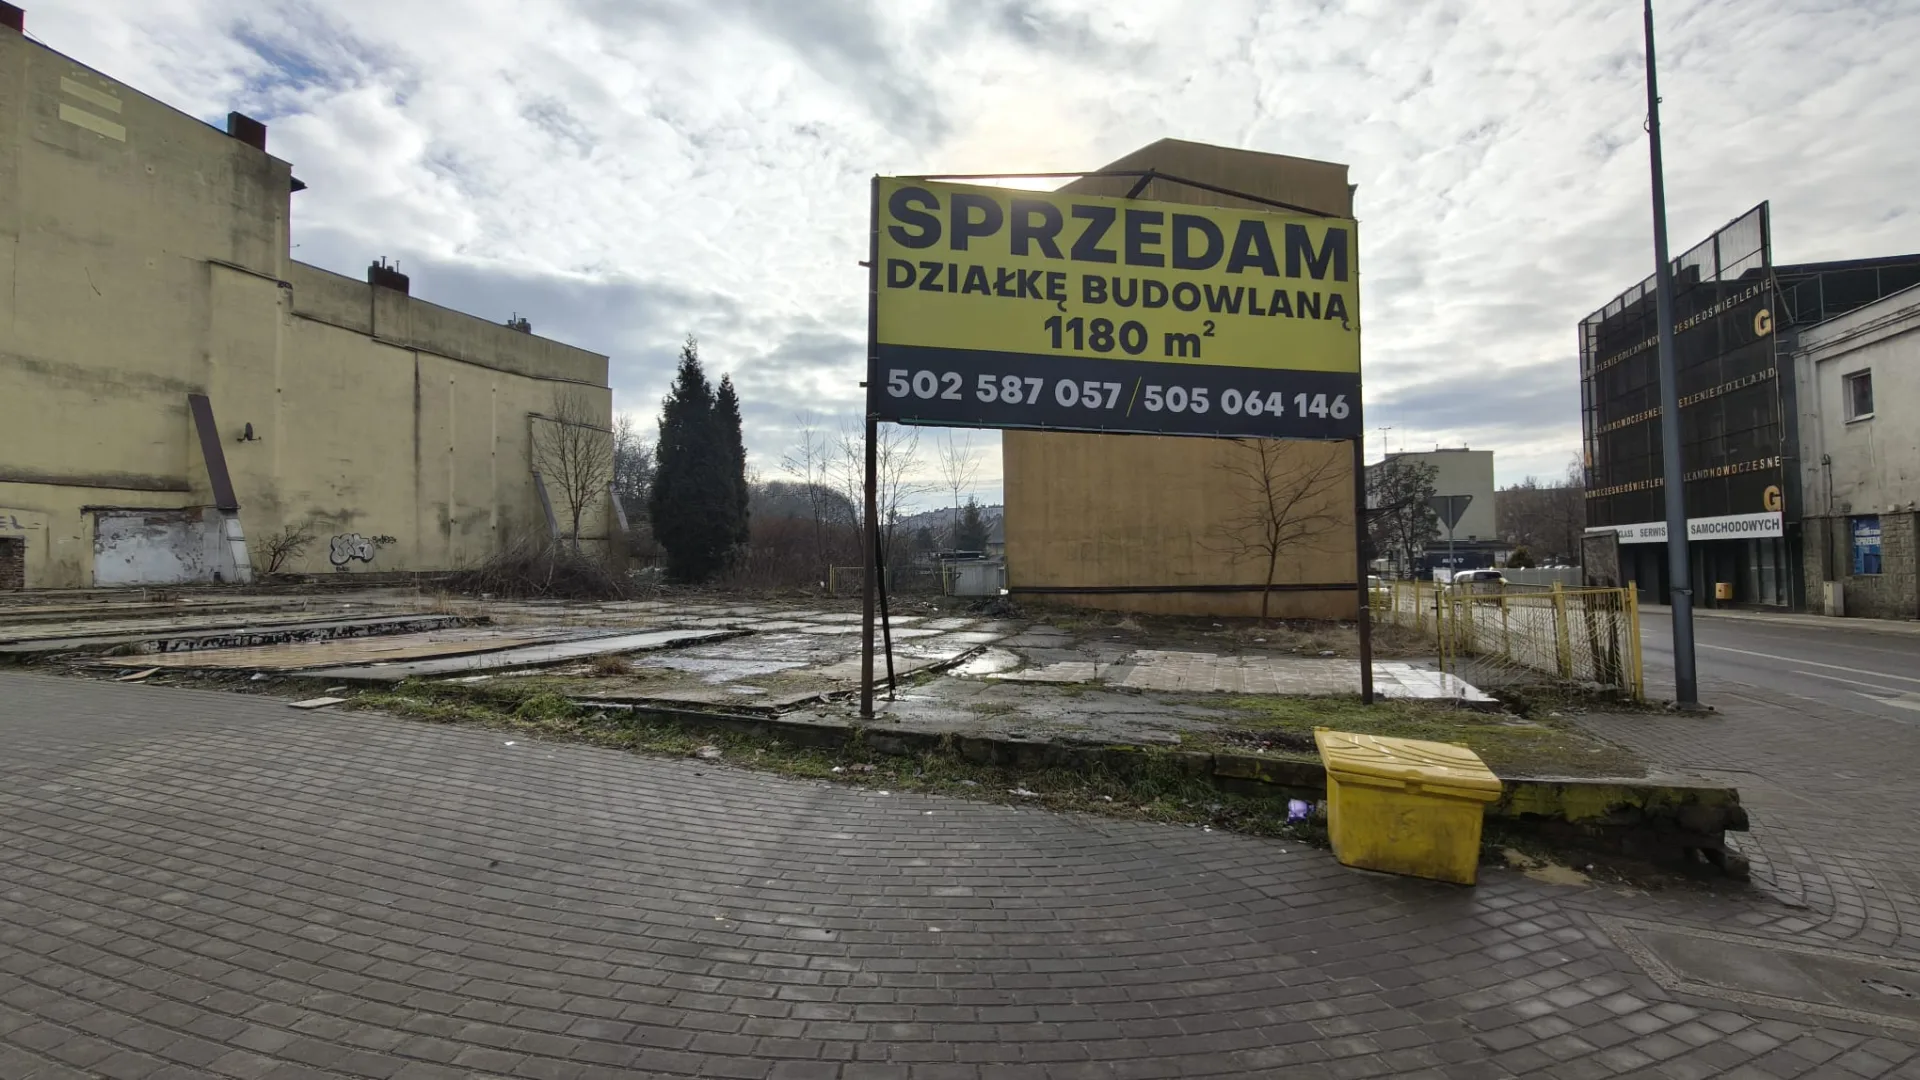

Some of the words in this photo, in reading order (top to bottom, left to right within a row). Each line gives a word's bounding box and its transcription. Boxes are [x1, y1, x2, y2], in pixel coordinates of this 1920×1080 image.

[887, 186, 1349, 282] SPRZEDAM
[887, 258, 1067, 312] DZIAŁKĘ
[1082, 274, 1351, 331] BUDOWLANĄ
[1044, 315, 1148, 355] 1180
[1754, 309, 1771, 337] G
[886, 368, 963, 400] 502
[975, 374, 1044, 405] 587
[1054, 379, 1122, 409] 057
[1144, 385, 1210, 413] 505
[1221, 388, 1284, 417] 064
[1293, 393, 1350, 420] 146
[1764, 485, 1781, 512] G
[1640, 526, 1666, 538] SERWIS
[1690, 518, 1780, 535] SAMOCHODOWYCH
